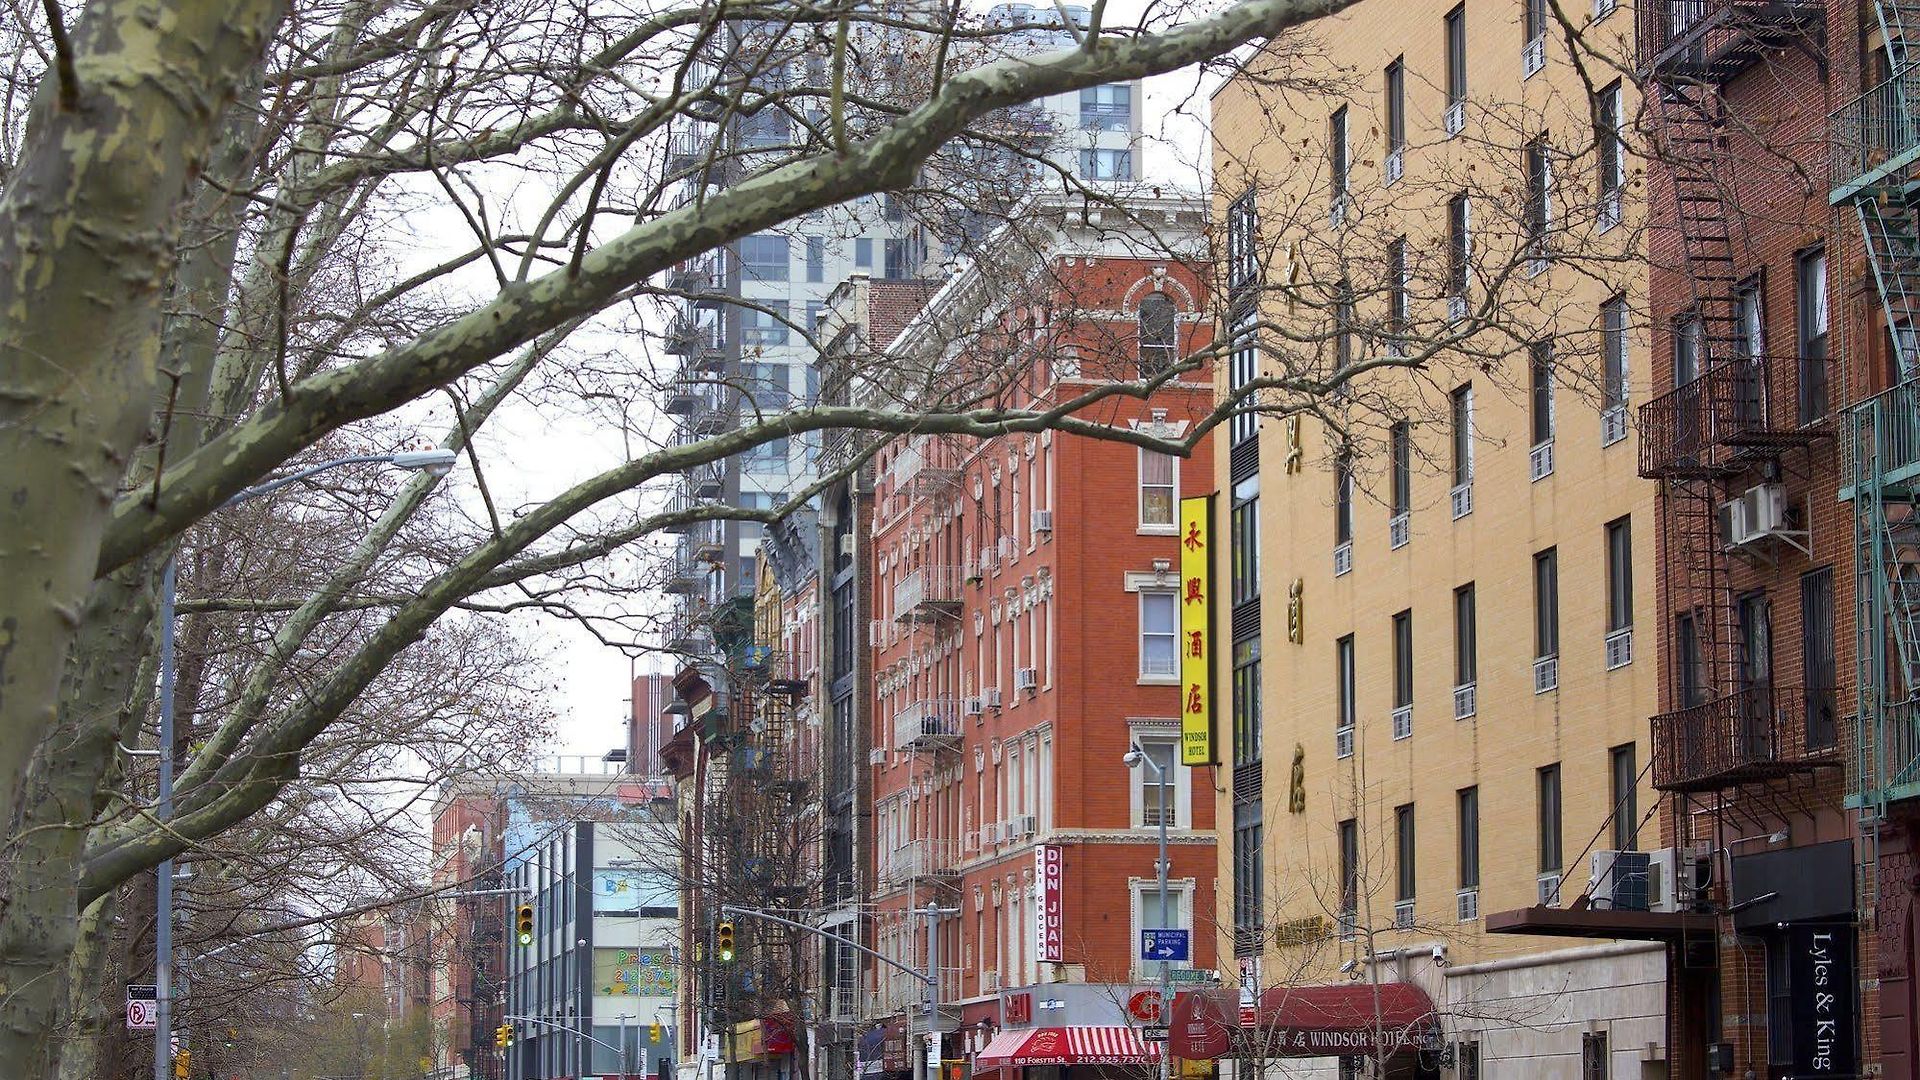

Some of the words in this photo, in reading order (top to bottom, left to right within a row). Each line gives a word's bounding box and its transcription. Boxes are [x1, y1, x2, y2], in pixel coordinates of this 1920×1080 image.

[1184, 731, 1207, 742] WINDSOR
[1188, 745, 1205, 756] HOTEL
[1046, 849, 1059, 890] DON
[1037, 895, 1045, 958] GROCERY
[1047, 901, 1060, 957] JUAN
[1157, 938, 1182, 946] PARKING
[1809, 932, 1832, 986] Lyles
[1815, 992, 1835, 1013] &
[1310, 1031, 1367, 1047] WINDSOR
[1812, 1019, 1836, 1070] King
[1014, 1057, 1026, 1065] 110
